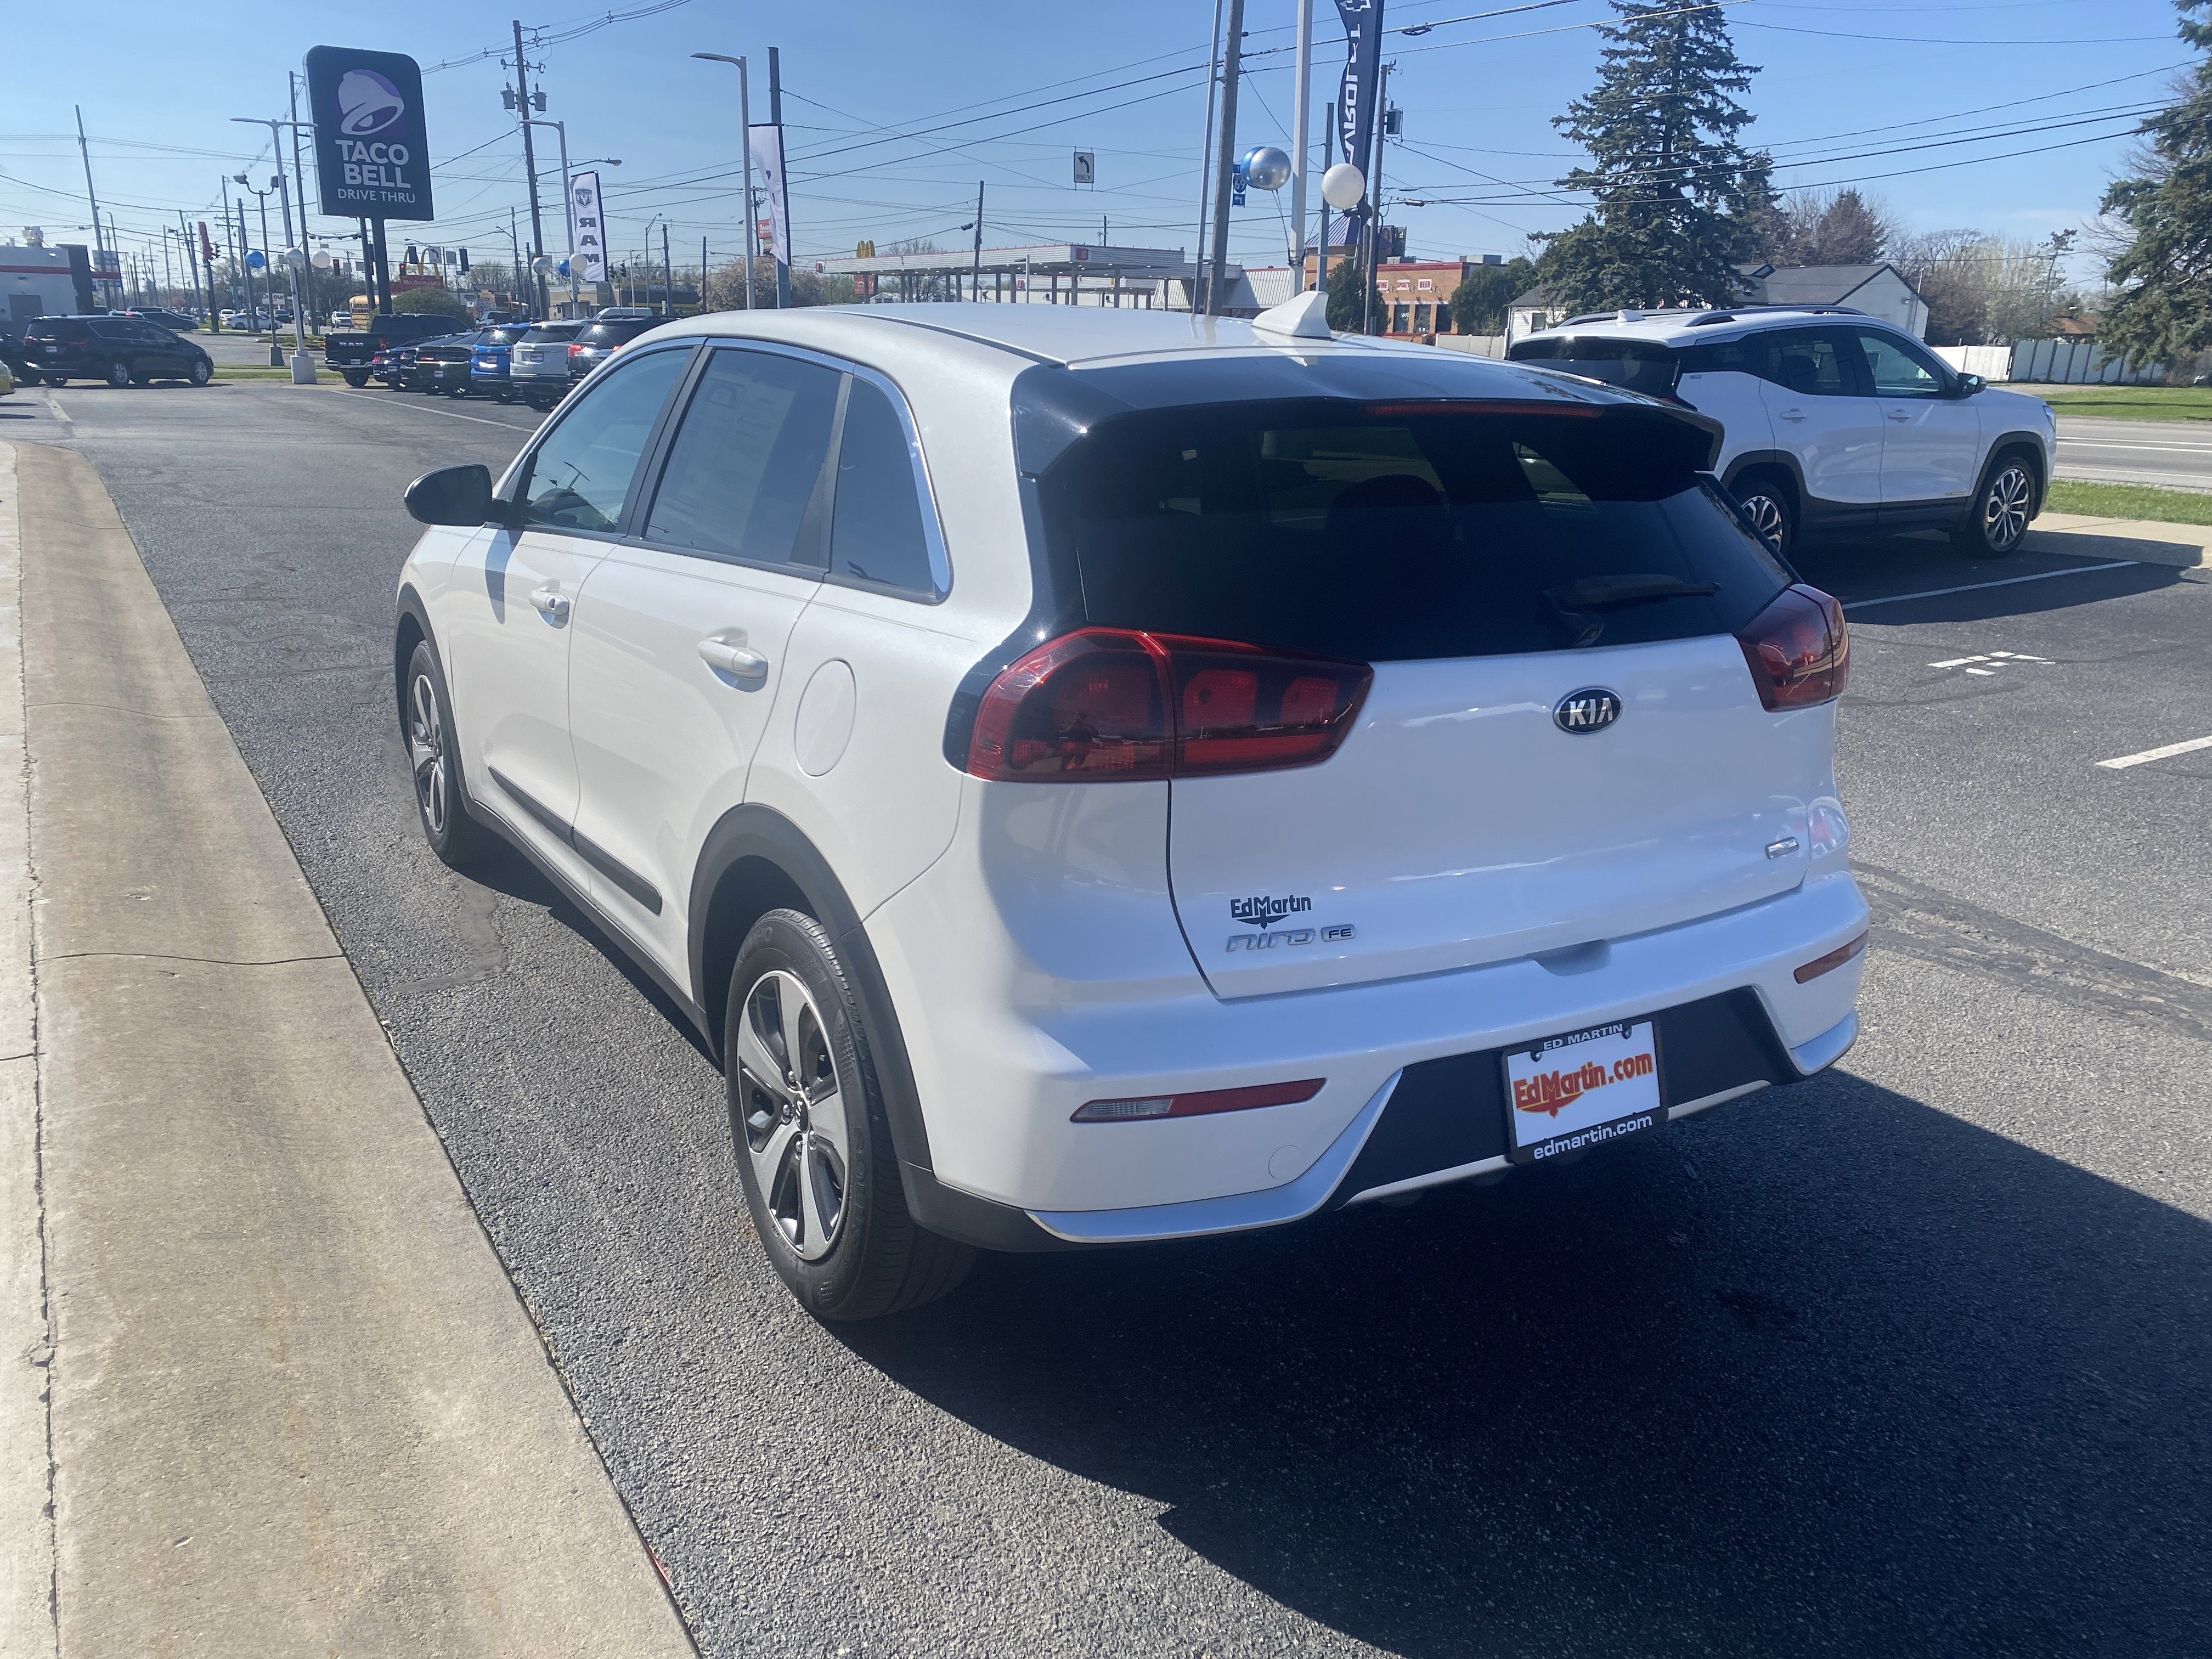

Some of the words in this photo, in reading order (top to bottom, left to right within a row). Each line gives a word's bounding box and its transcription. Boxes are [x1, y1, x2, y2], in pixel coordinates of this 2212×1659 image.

[335, 139, 409, 165] TACO
[343, 163, 411, 188] BELL
[1234, 179, 1246, 189] 69
[337, 188, 377, 201] DRIVE
[379, 191, 415, 204] THRU
[1568, 697, 1613, 726] KIA
[1231, 894, 1312, 918] EdMartin
[1329, 928, 1352, 939] FE
[1543, 1039, 1564, 1051] ED
[1567, 1024, 1623, 1045] MARTIN
[1513, 1053, 1654, 1110] EdMartin.com
[1534, 1115, 1652, 1160] edmartin.com
